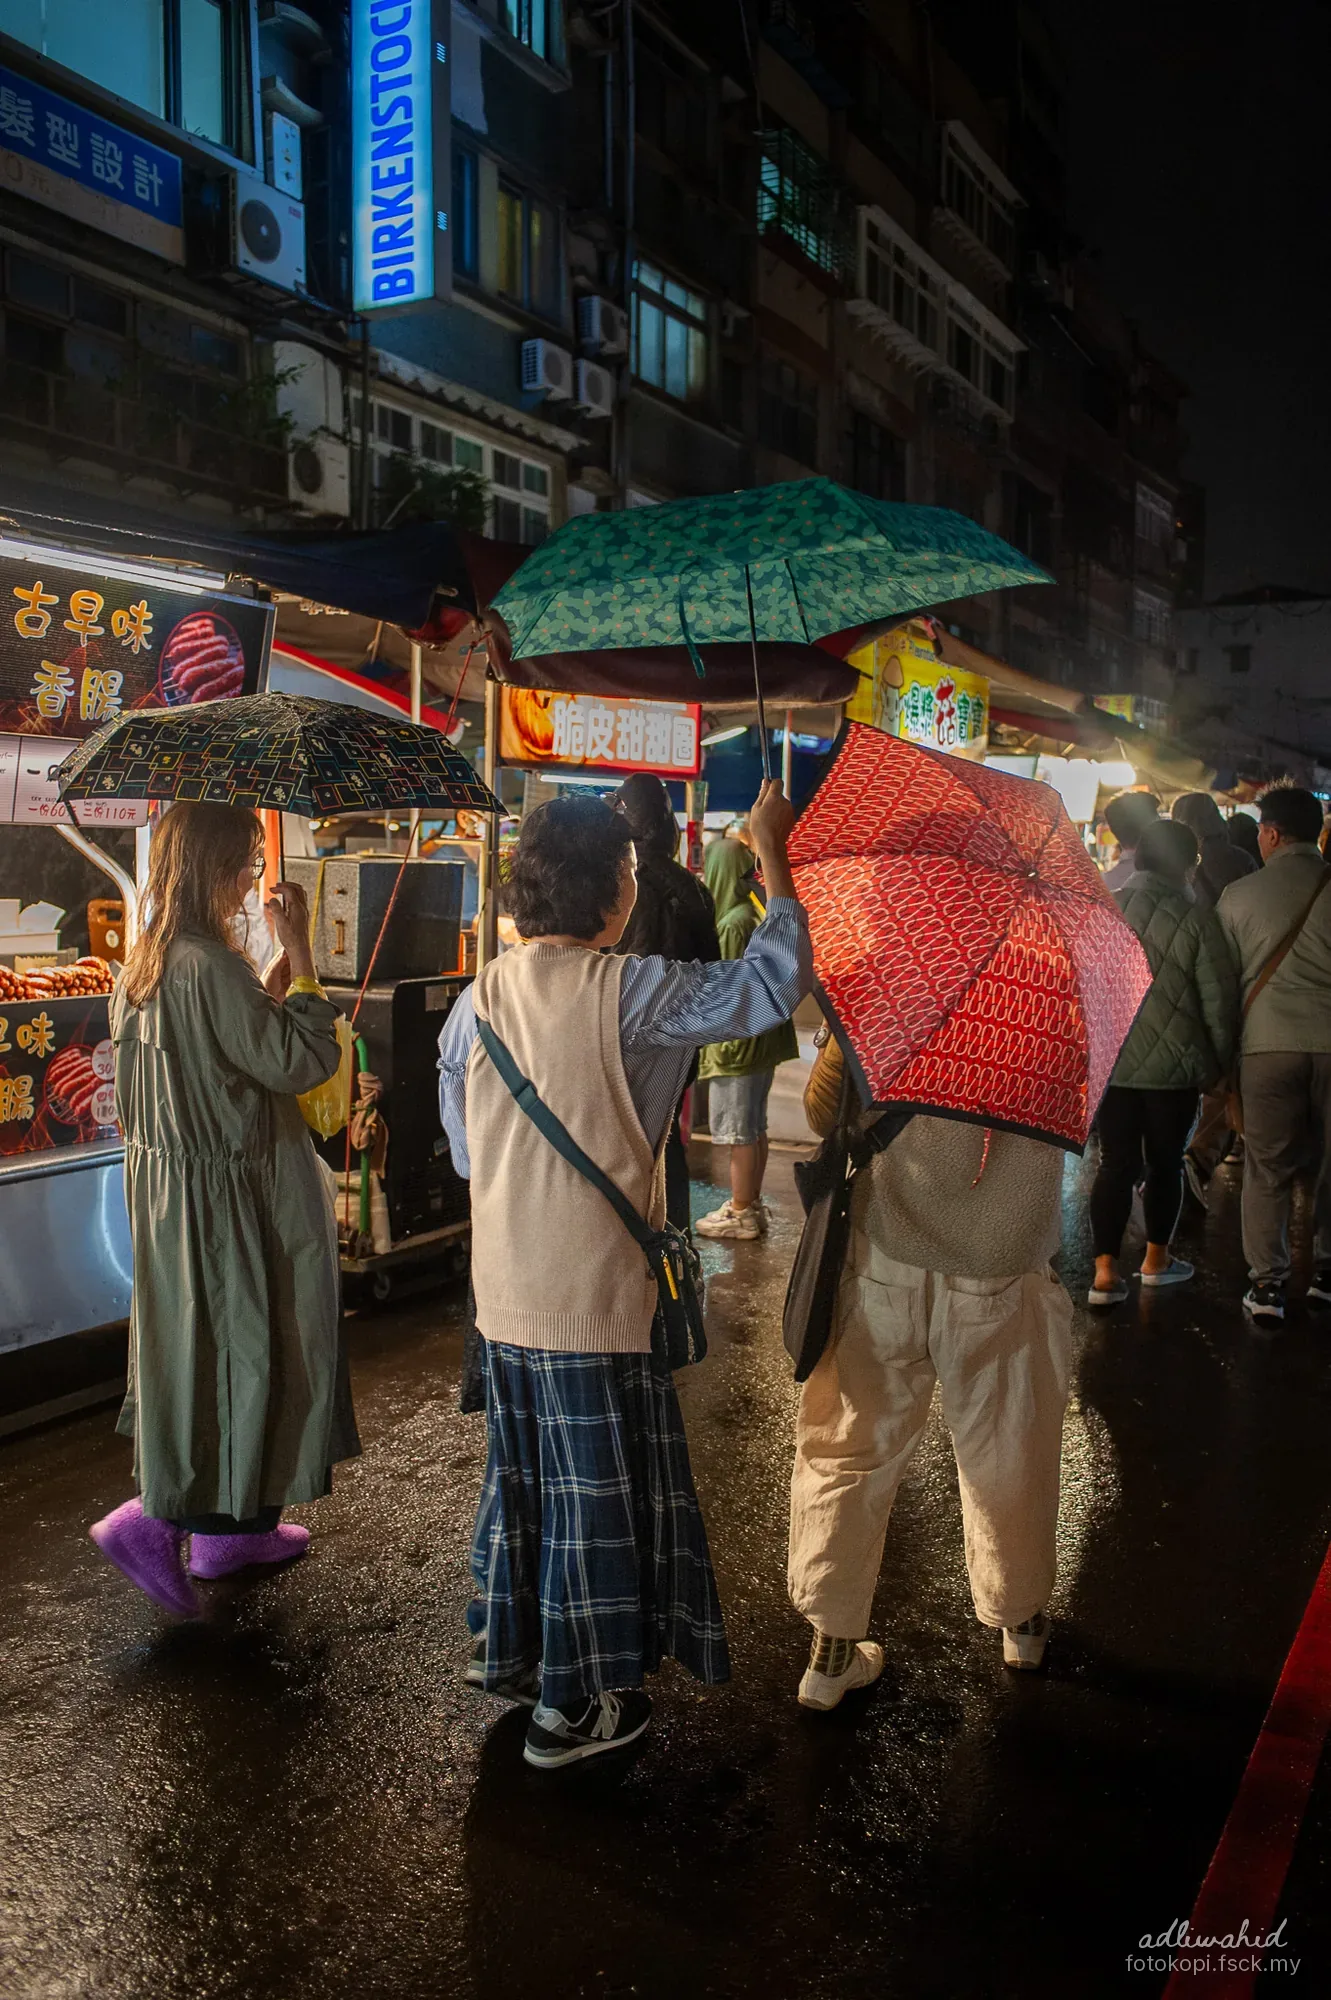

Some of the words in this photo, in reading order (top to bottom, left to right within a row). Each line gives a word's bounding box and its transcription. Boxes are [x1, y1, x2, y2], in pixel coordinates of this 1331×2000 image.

[0, 86, 163, 207] 髮型設計
[13, 580, 153, 655] 古早味
[29, 659, 123, 722] 香腸
[552, 699, 696, 767] 脆皮甜甜圈
